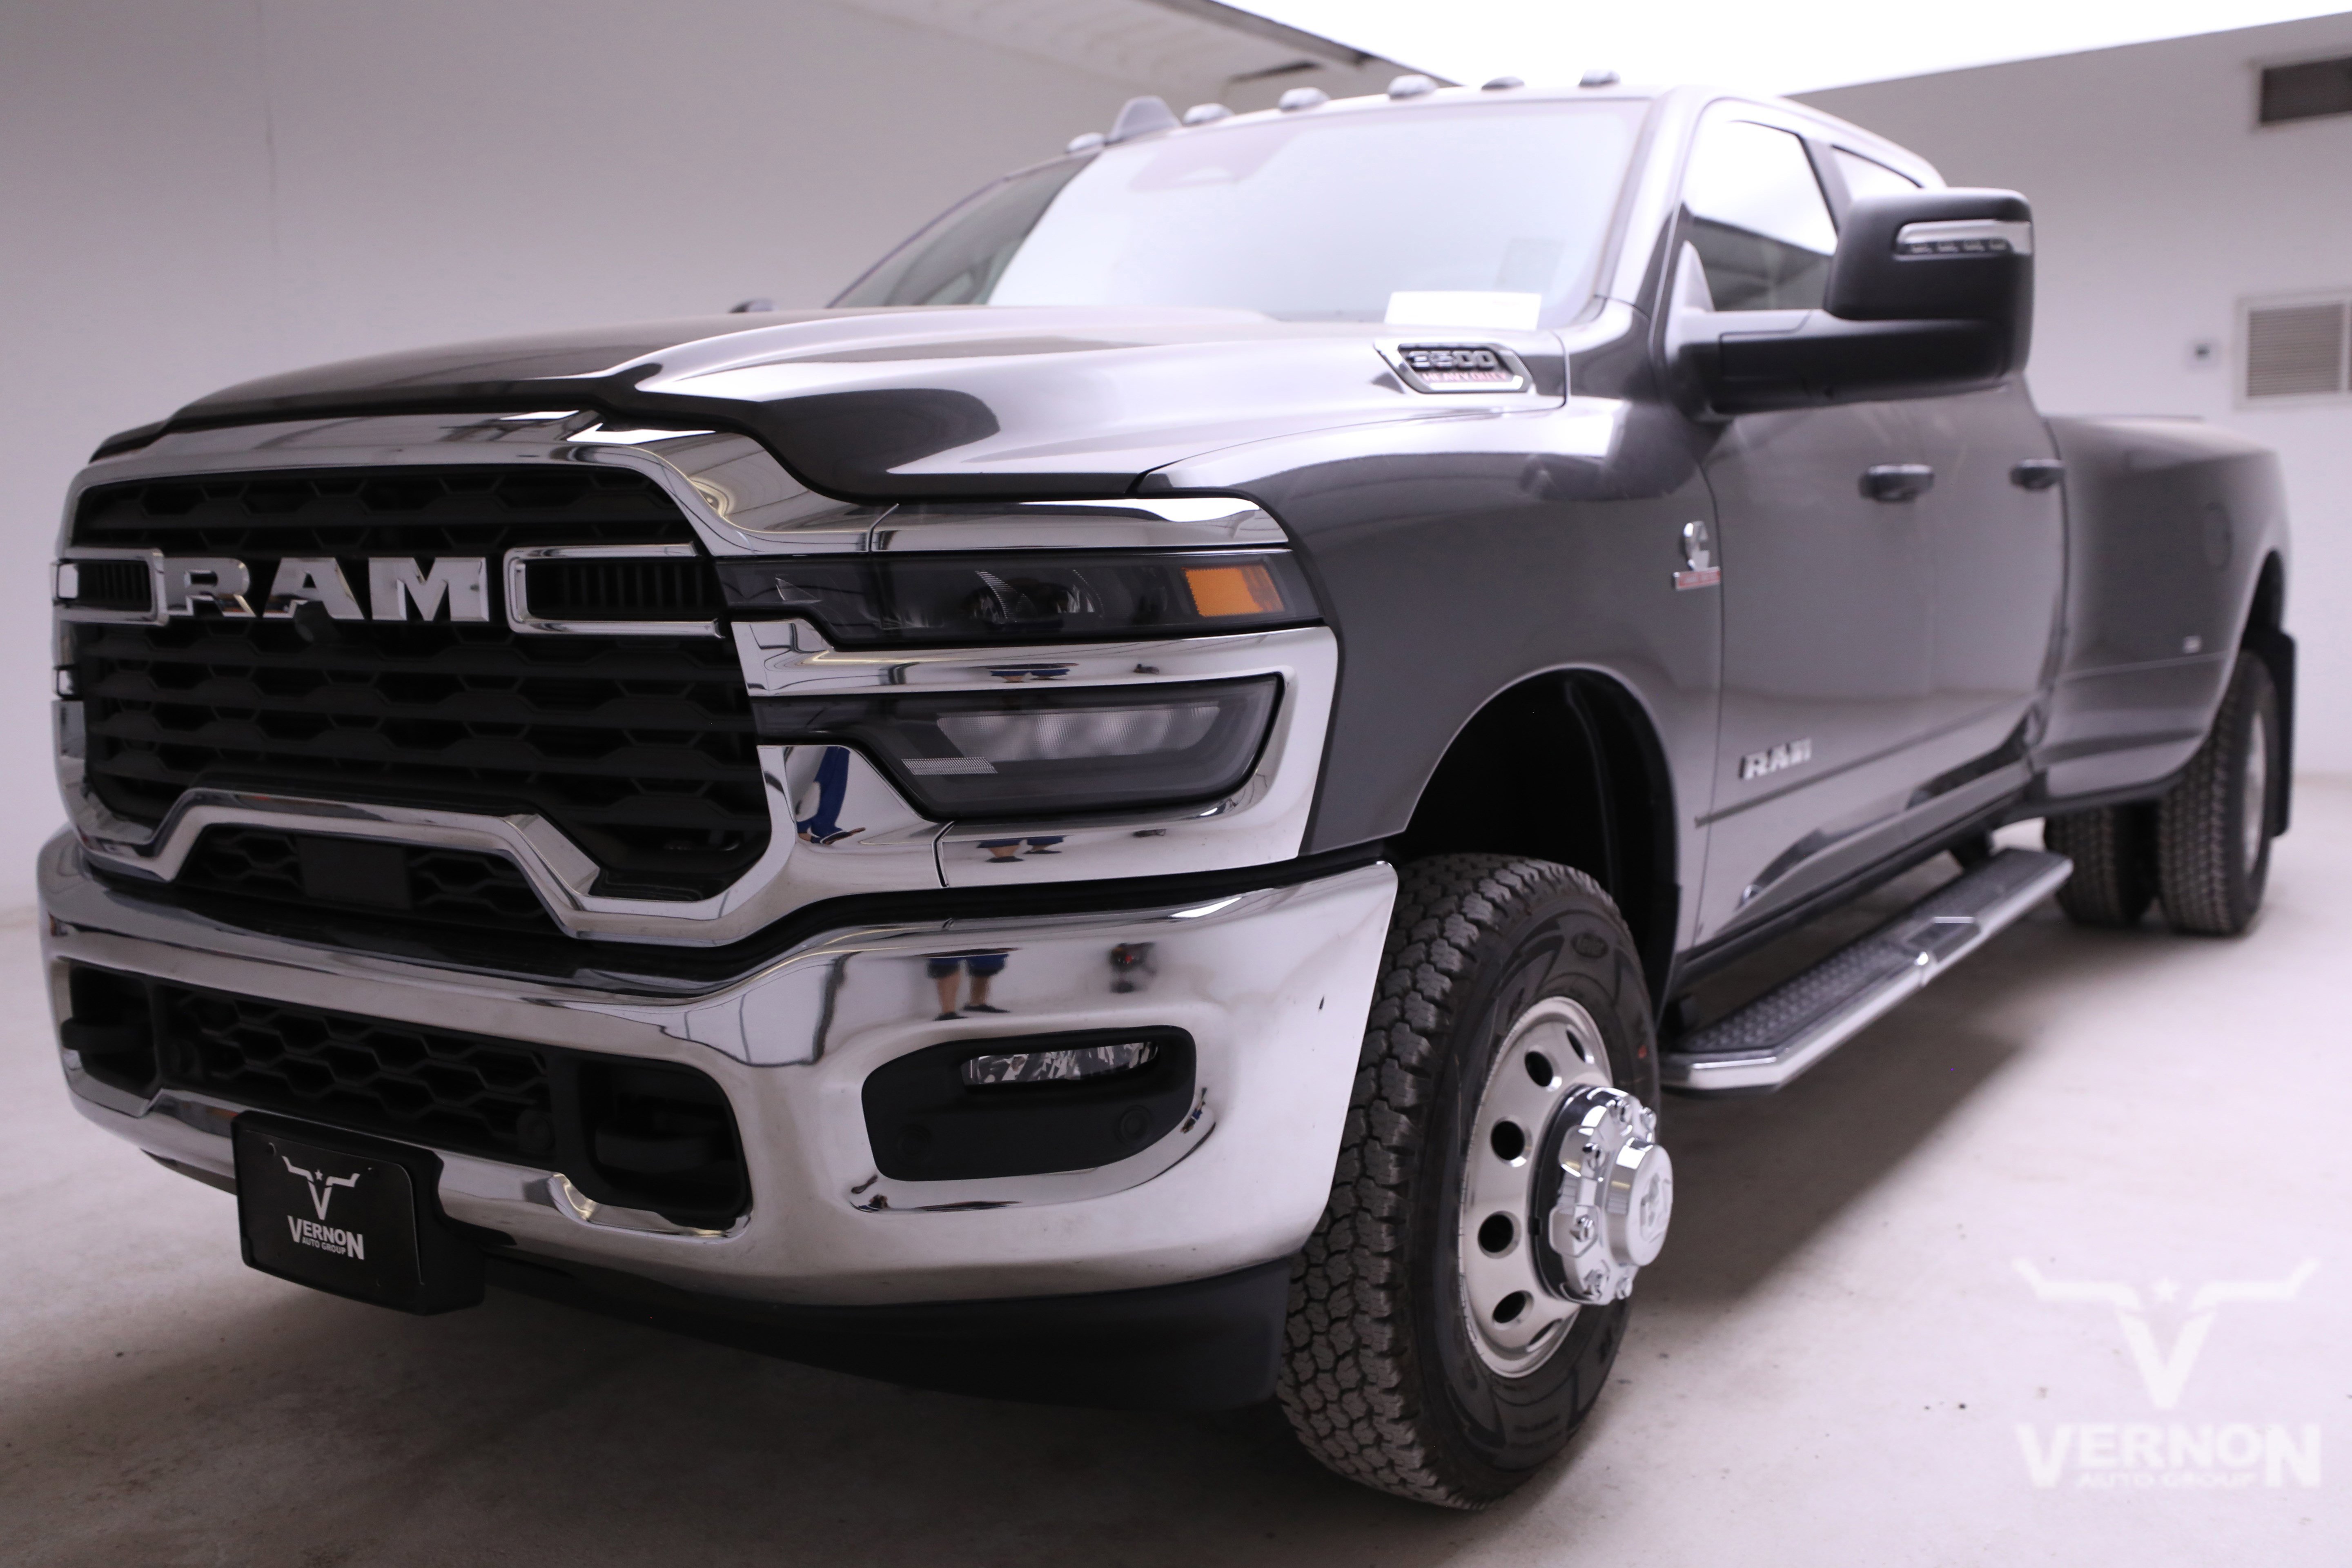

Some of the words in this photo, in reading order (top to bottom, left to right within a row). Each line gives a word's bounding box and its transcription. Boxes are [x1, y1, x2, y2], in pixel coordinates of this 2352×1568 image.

[1422, 372, 1469, 381] HEAVY
[1471, 372, 1506, 381] DUTY
[164, 557, 490, 621] RAM
[1744, 738, 1812, 780] RAM
[287, 1215, 364, 1260] VERNON
[302, 1236, 320, 1248] AUTO
[321, 1242, 346, 1255] GROUP
